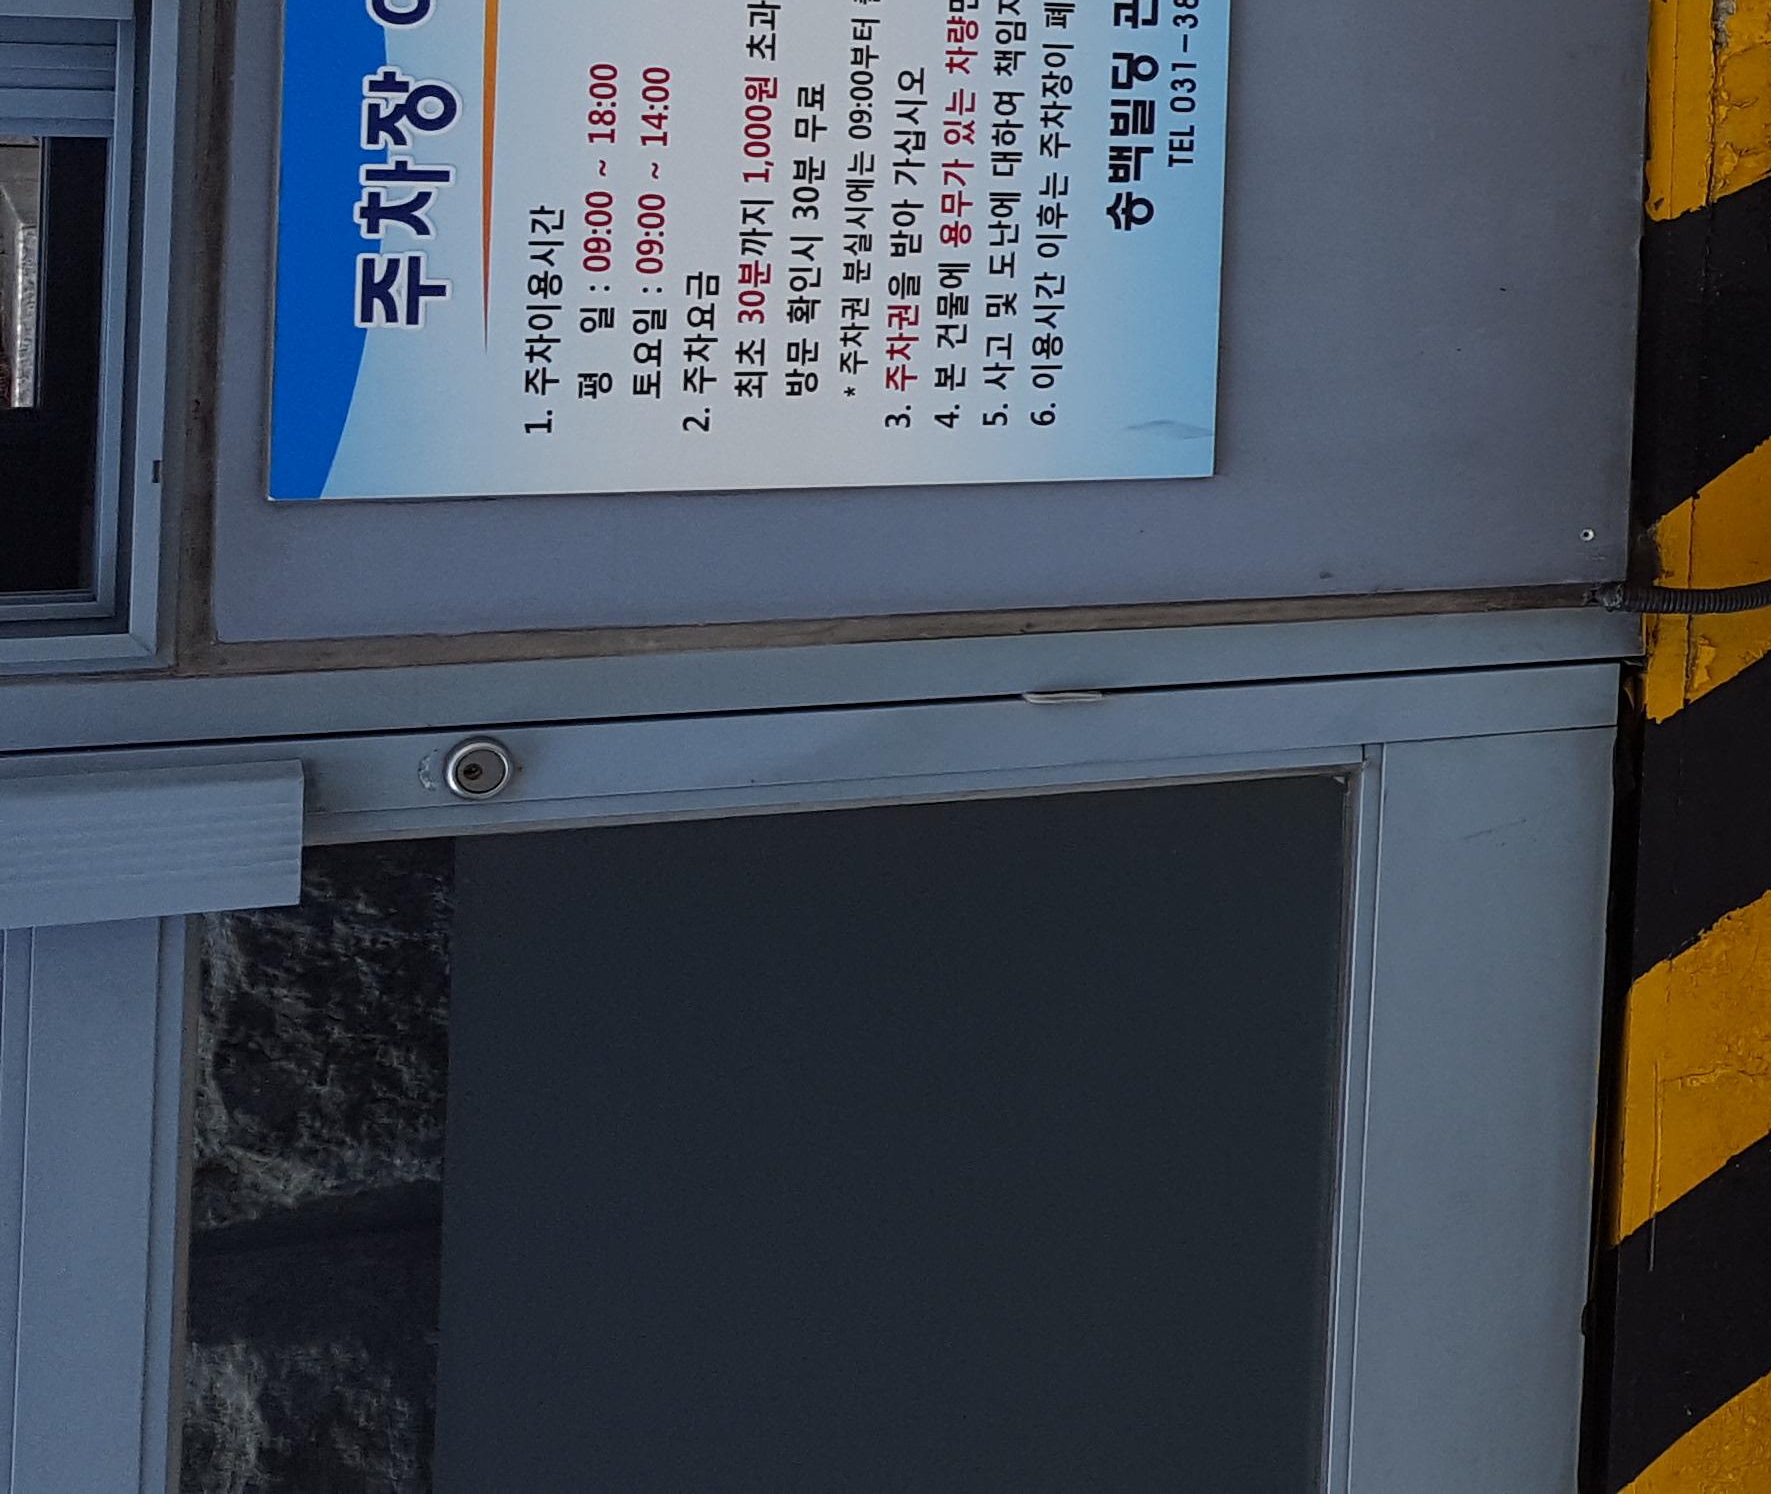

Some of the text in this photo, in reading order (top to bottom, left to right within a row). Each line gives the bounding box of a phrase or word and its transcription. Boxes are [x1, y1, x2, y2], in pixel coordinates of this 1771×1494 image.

[746, 0, 781, 61] 초과
[588, 64, 617, 143] 18:00
[640, 67, 670, 146] 14:00
[848, 18, 880, 139] 09:00부터
[943, 88, 975, 145] 있는
[1040, 44, 1074, 159] 주차장이
[743, 77, 777, 183] 1,000원
[990, 92, 1025, 176] 대하여
[1106, 52, 1159, 231] 송백빌딩
[1168, 125, 1194, 167] TEL
[352, 66, 459, 330] 주차장
[583, 192, 613, 272] 09:00
[635, 194, 666, 274] 09:00
[785, 84, 828, 396] 방문 확인시 30분 무료
[843, 151, 875, 284] 분실시에는
[940, 159, 974, 248] 용무가
[988, 192, 1021, 278] 도난에
[1035, 172, 1068, 258] 이후는
[738, 200, 774, 324] 30분까지
[885, 67, 928, 428] 3. 주차권을 받아 가십시오
[524, 205, 564, 434] 1. 주차이용시간
[840, 298, 870, 375] 주차권
[936, 263, 971, 349] 건물에
[985, 293, 1017, 317] 및
[1031, 272, 1065, 388] 이용시간
[632, 309, 667, 399] 토요일
[682, 271, 720, 432] 2. 주차요금
[734, 338, 768, 398] 최초
[934, 364, 966, 391] 본
[983, 333, 1015, 390] 사고
[934, 404, 960, 429] 4.
[983, 404, 1008, 426] 5.
[1030, 403, 1056, 426] 6.
